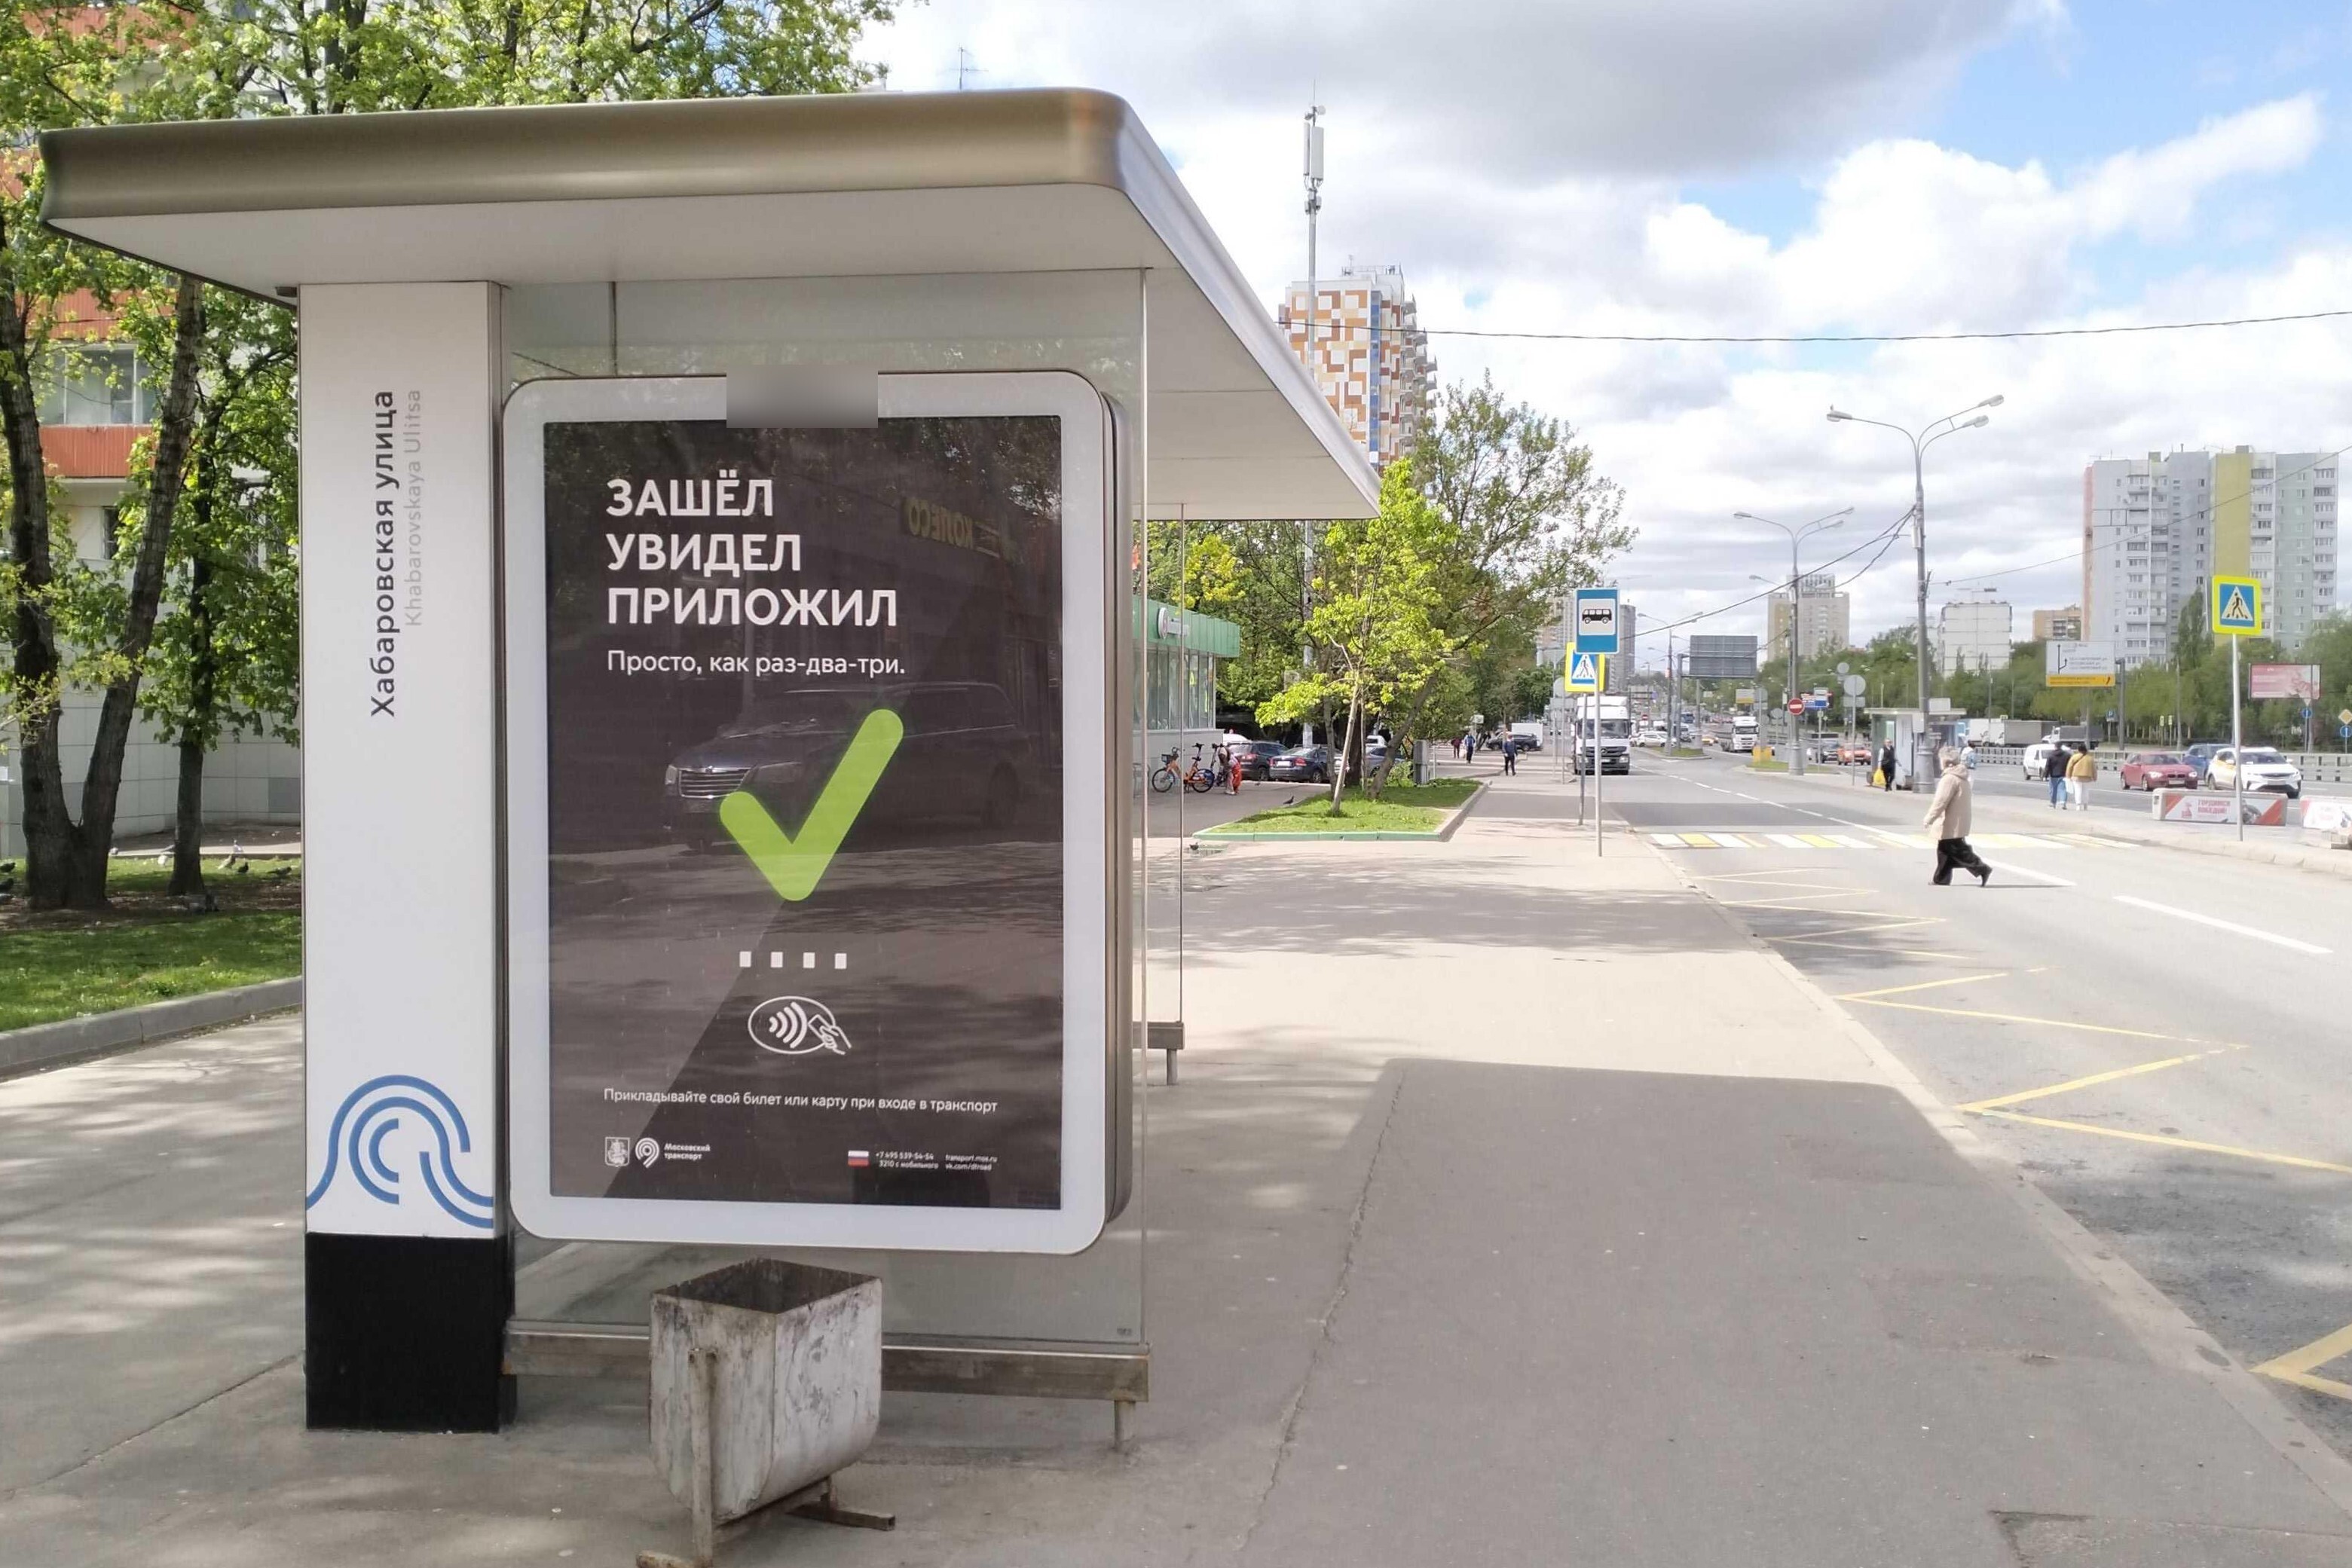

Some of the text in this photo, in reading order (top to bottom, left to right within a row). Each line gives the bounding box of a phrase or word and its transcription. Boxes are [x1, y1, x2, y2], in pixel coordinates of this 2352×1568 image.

[403, 390, 425, 626] Khabarovskaya Ulitsa
[606, 469, 773, 516] ЗАШЁЛ
[370, 390, 400, 717] Хабаровская улица
[606, 533, 801, 577] УВИДЕЛ
[607, 587, 897, 626] ПРИЛОЖИЛ
[607, 650, 905, 677] Просто, как раз-два-три.
[604, 1087, 998, 1114] Прикладывайте свой билет или карту при входе в транспорт
[664, 1142, 711, 1152] Московский
